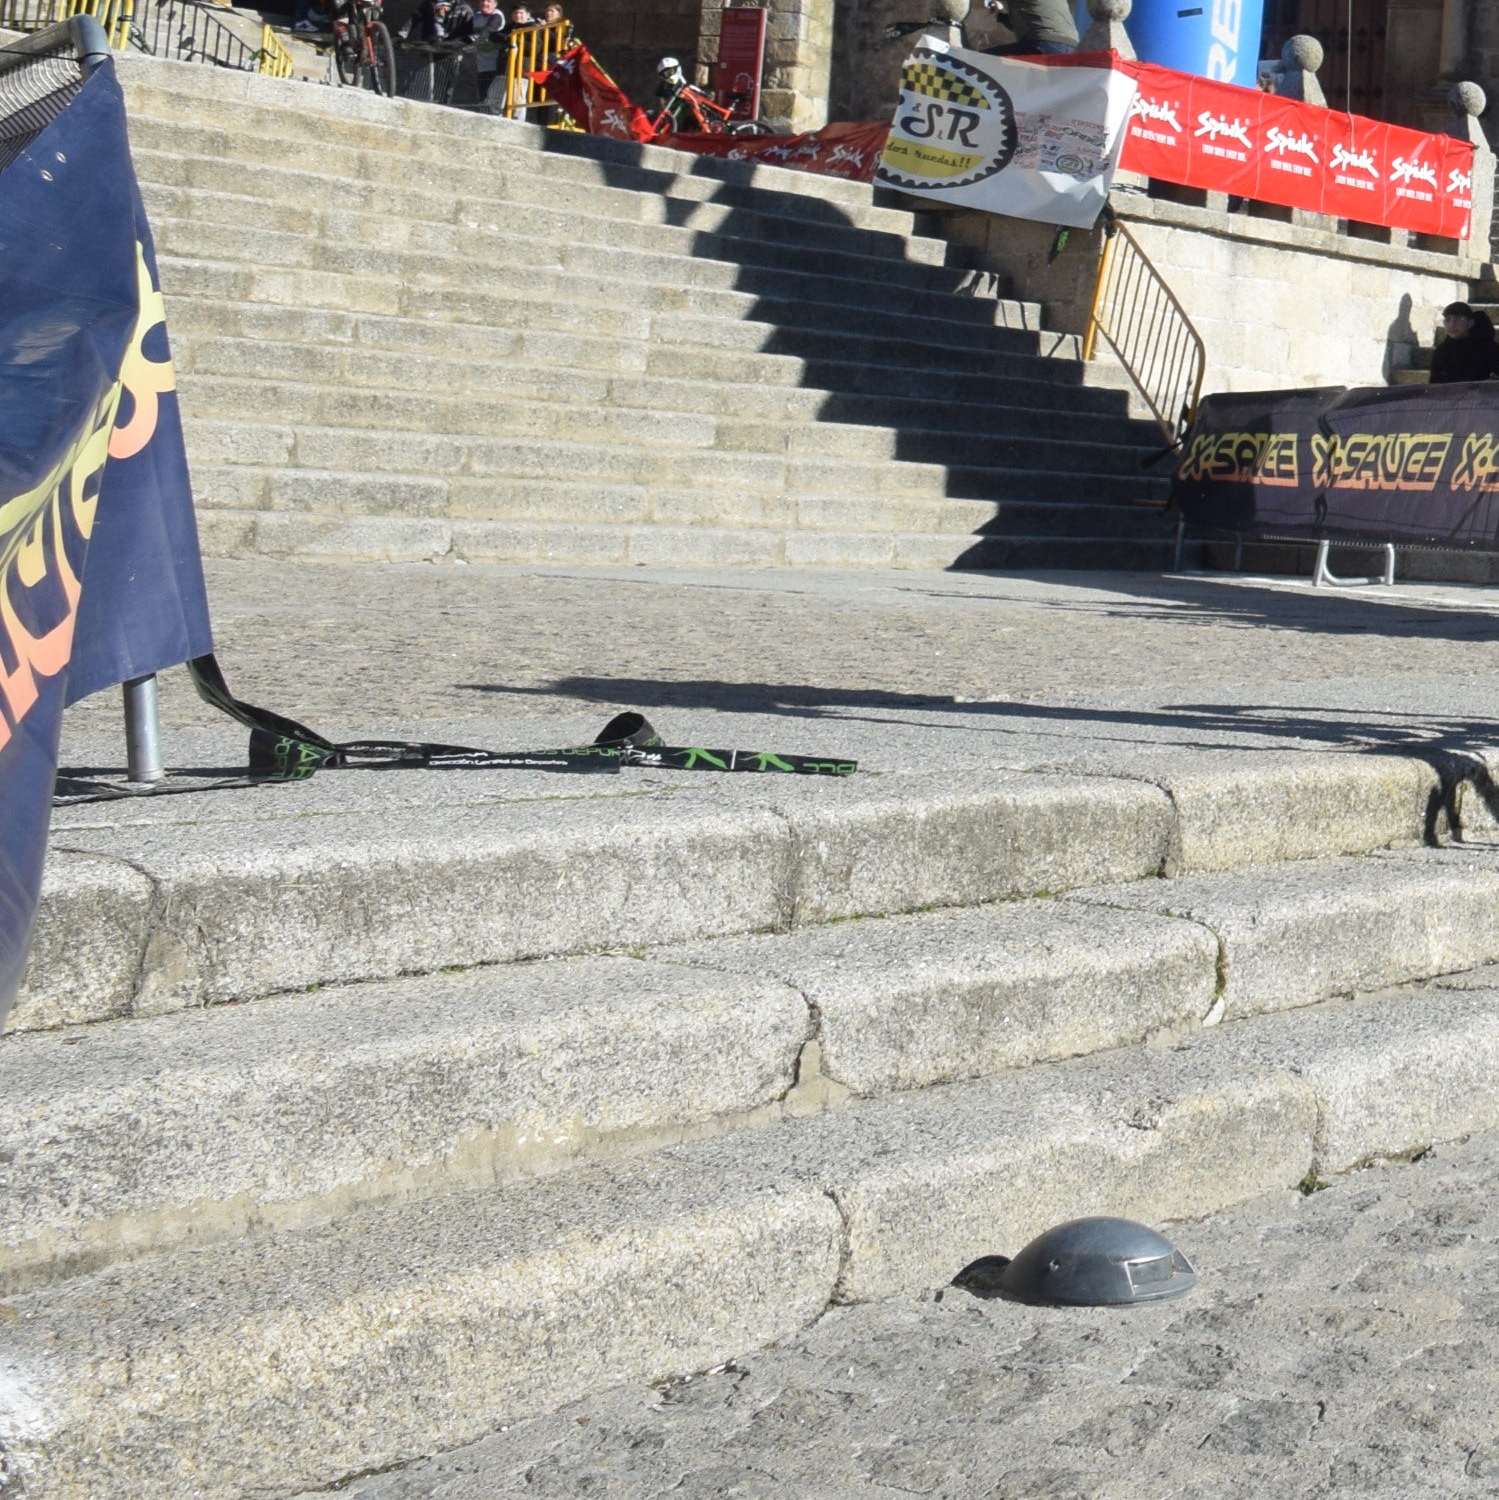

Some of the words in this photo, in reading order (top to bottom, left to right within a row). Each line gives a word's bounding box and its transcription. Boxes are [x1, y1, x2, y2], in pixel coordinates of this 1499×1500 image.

[1129, 92, 1182, 133] Spiuk
[1194, 111, 1252, 149] Spiuk
[1264, 126, 1319, 165] Spiuk
[1329, 143, 1379, 179] Spiuk
[1389, 157, 1438, 190] Spiuk
[1446, 168, 1471, 194] Spi
